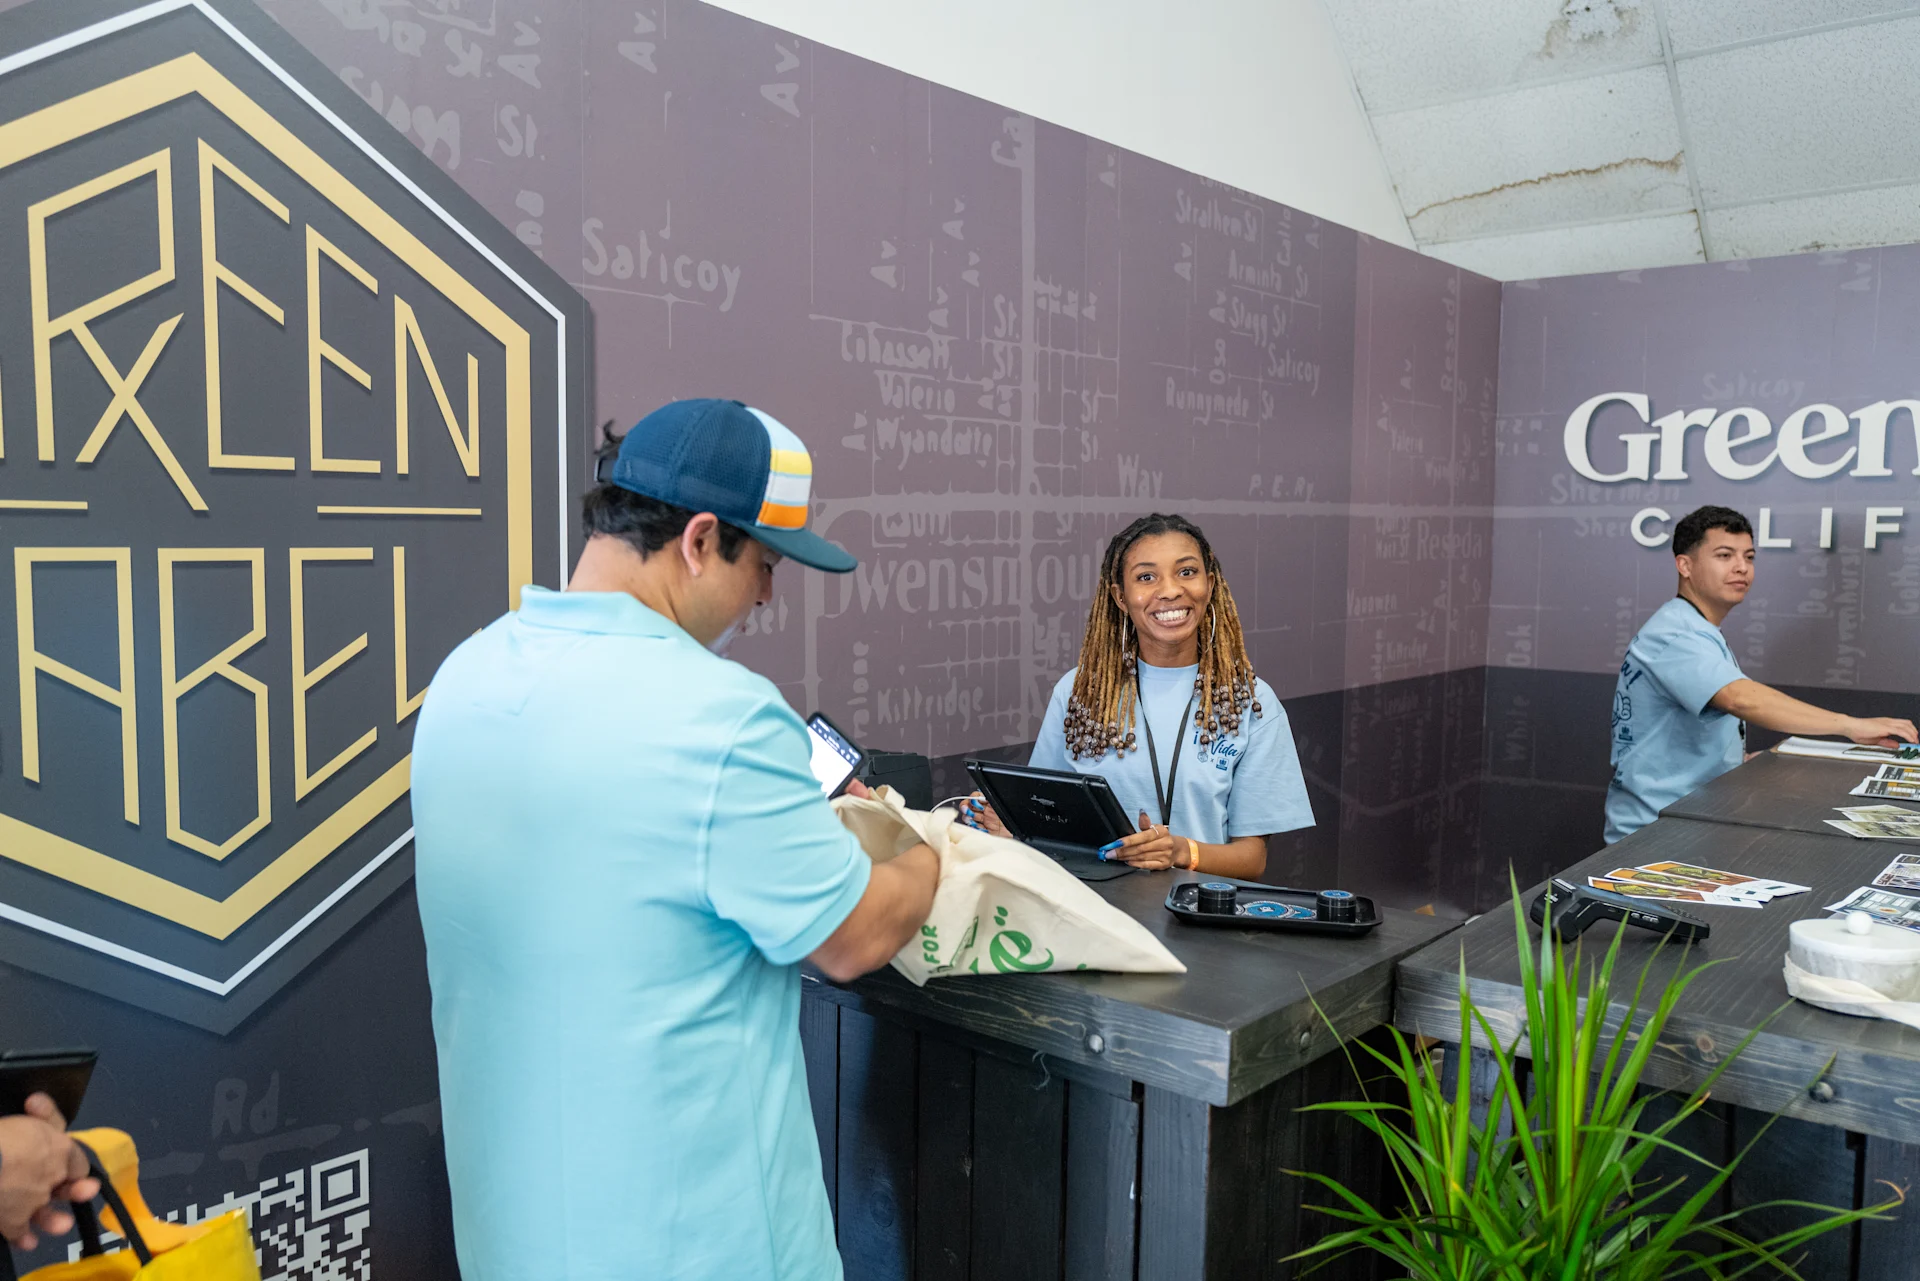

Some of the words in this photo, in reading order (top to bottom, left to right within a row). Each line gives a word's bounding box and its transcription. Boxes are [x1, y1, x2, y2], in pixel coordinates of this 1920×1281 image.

[581, 216, 742, 313] Saticoy
[1228, 249, 1283, 293] Arminta
[1267, 342, 1321, 397] Saticoy
[1165, 376, 1250, 427] Runnymede
[875, 416, 993, 471] Wyandotte
[1117, 452, 1163, 498] Way
[1416, 518, 1483, 562] Reseda
[1629, 506, 1904, 550] CLIF
[877, 676, 984, 734] Kittridge
[921, 924, 941, 965] FOR
